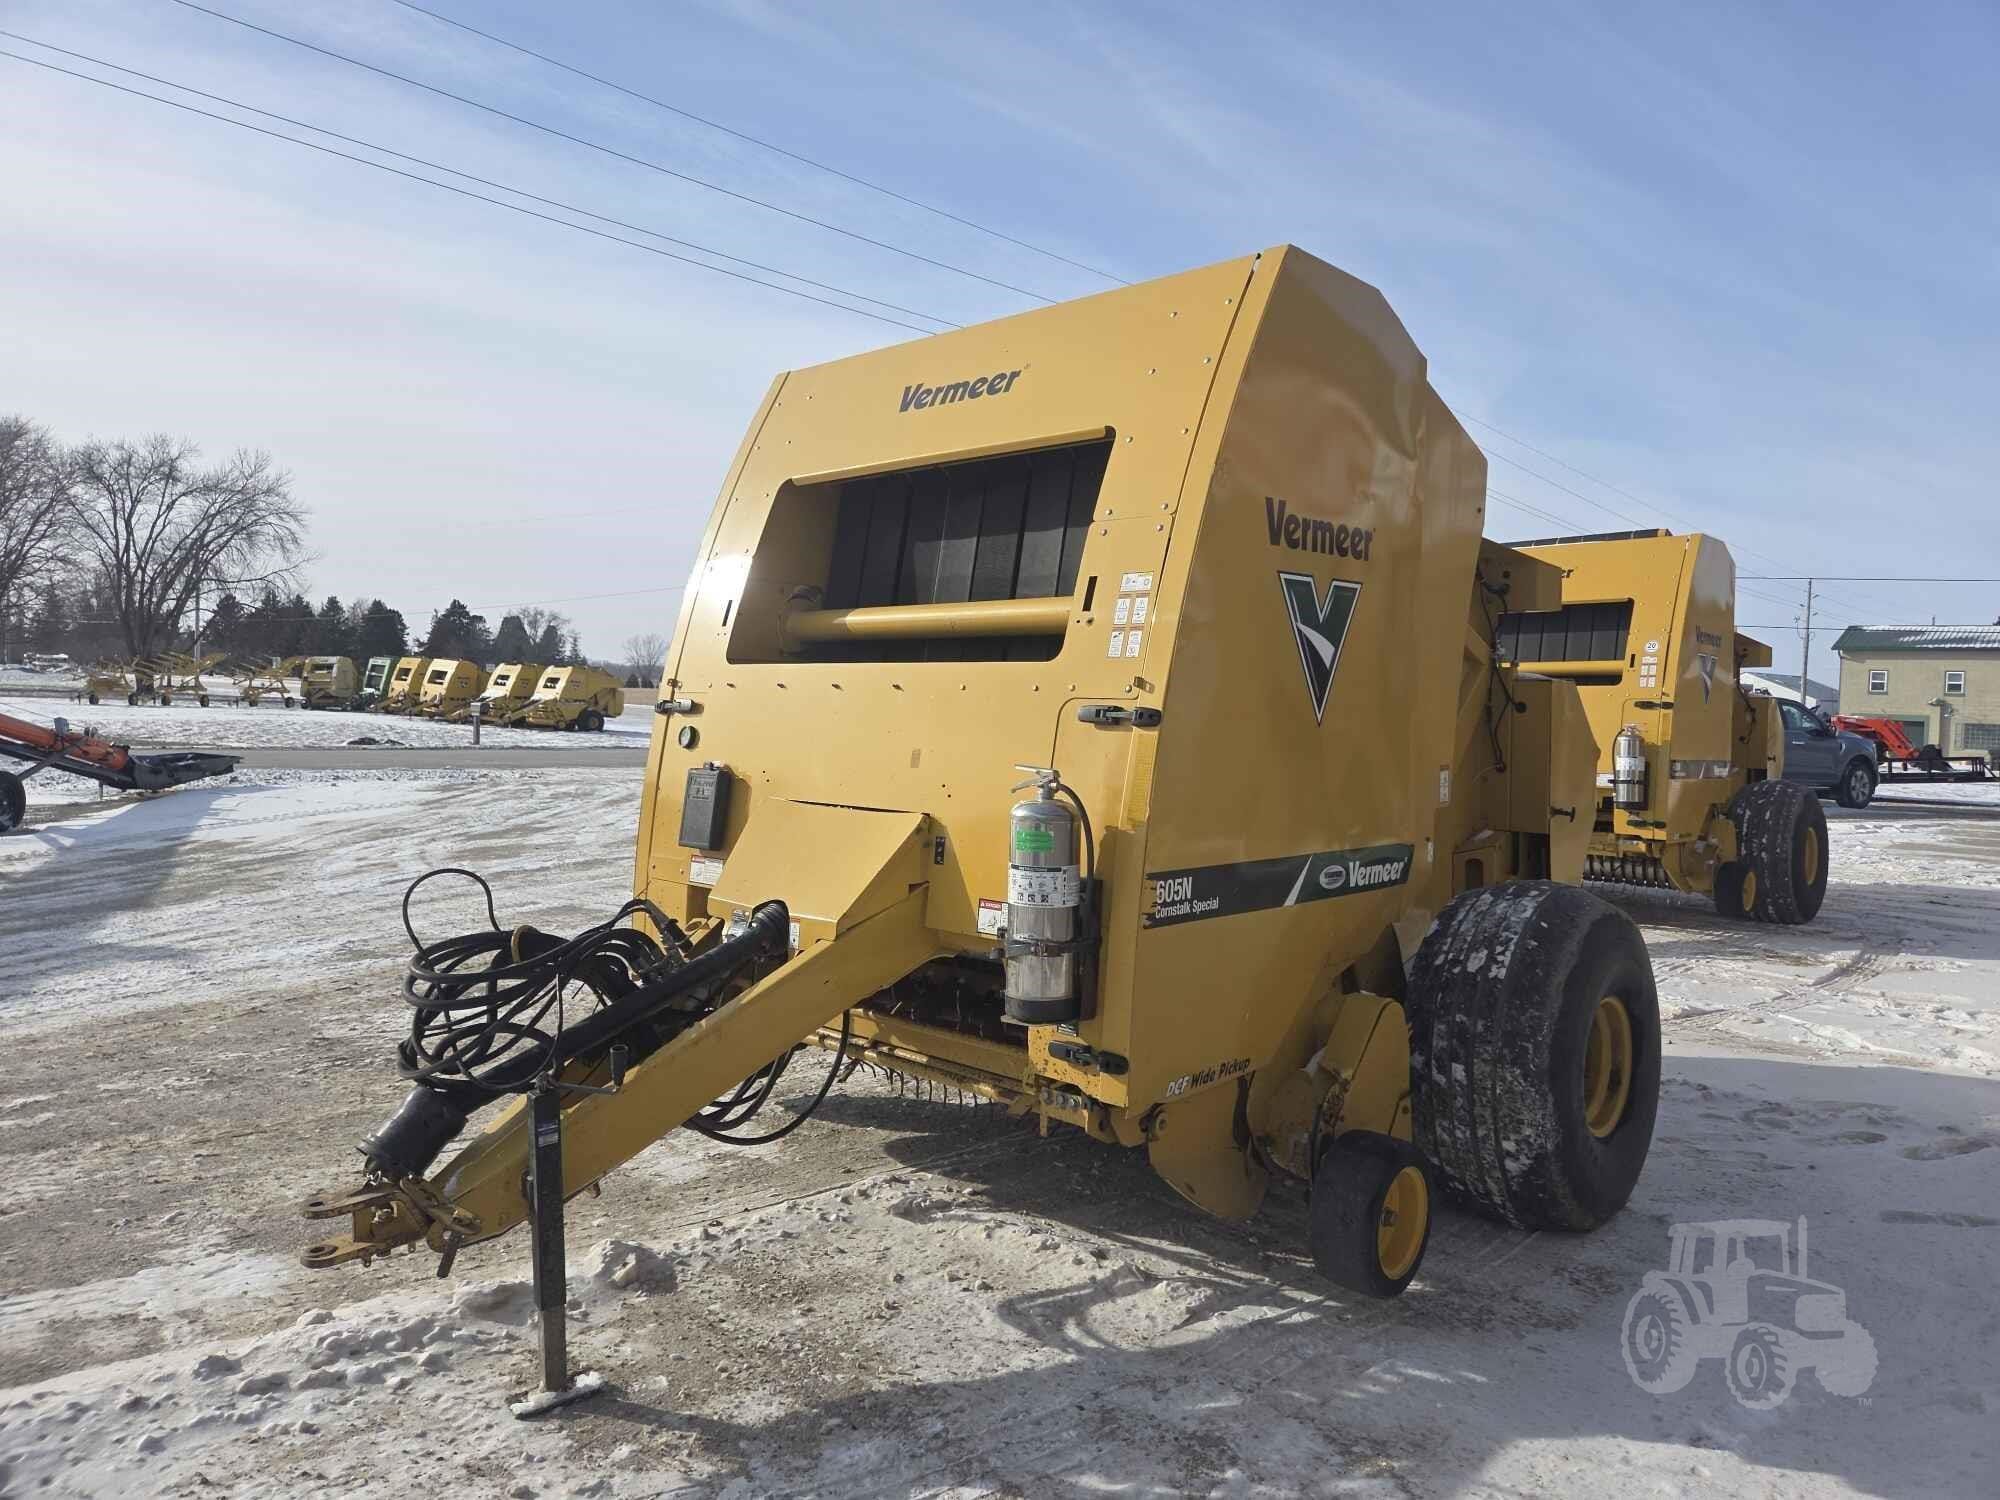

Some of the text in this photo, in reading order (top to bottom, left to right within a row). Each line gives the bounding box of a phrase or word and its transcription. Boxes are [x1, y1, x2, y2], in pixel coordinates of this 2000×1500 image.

[898, 369, 1022, 413] Vermeer
[1265, 496, 1374, 562] Vermeer
[1348, 860, 1405, 888] Vermeer
[1156, 876, 1193, 904] 605N
[1155, 896, 1219, 919] Cornstalk Special
